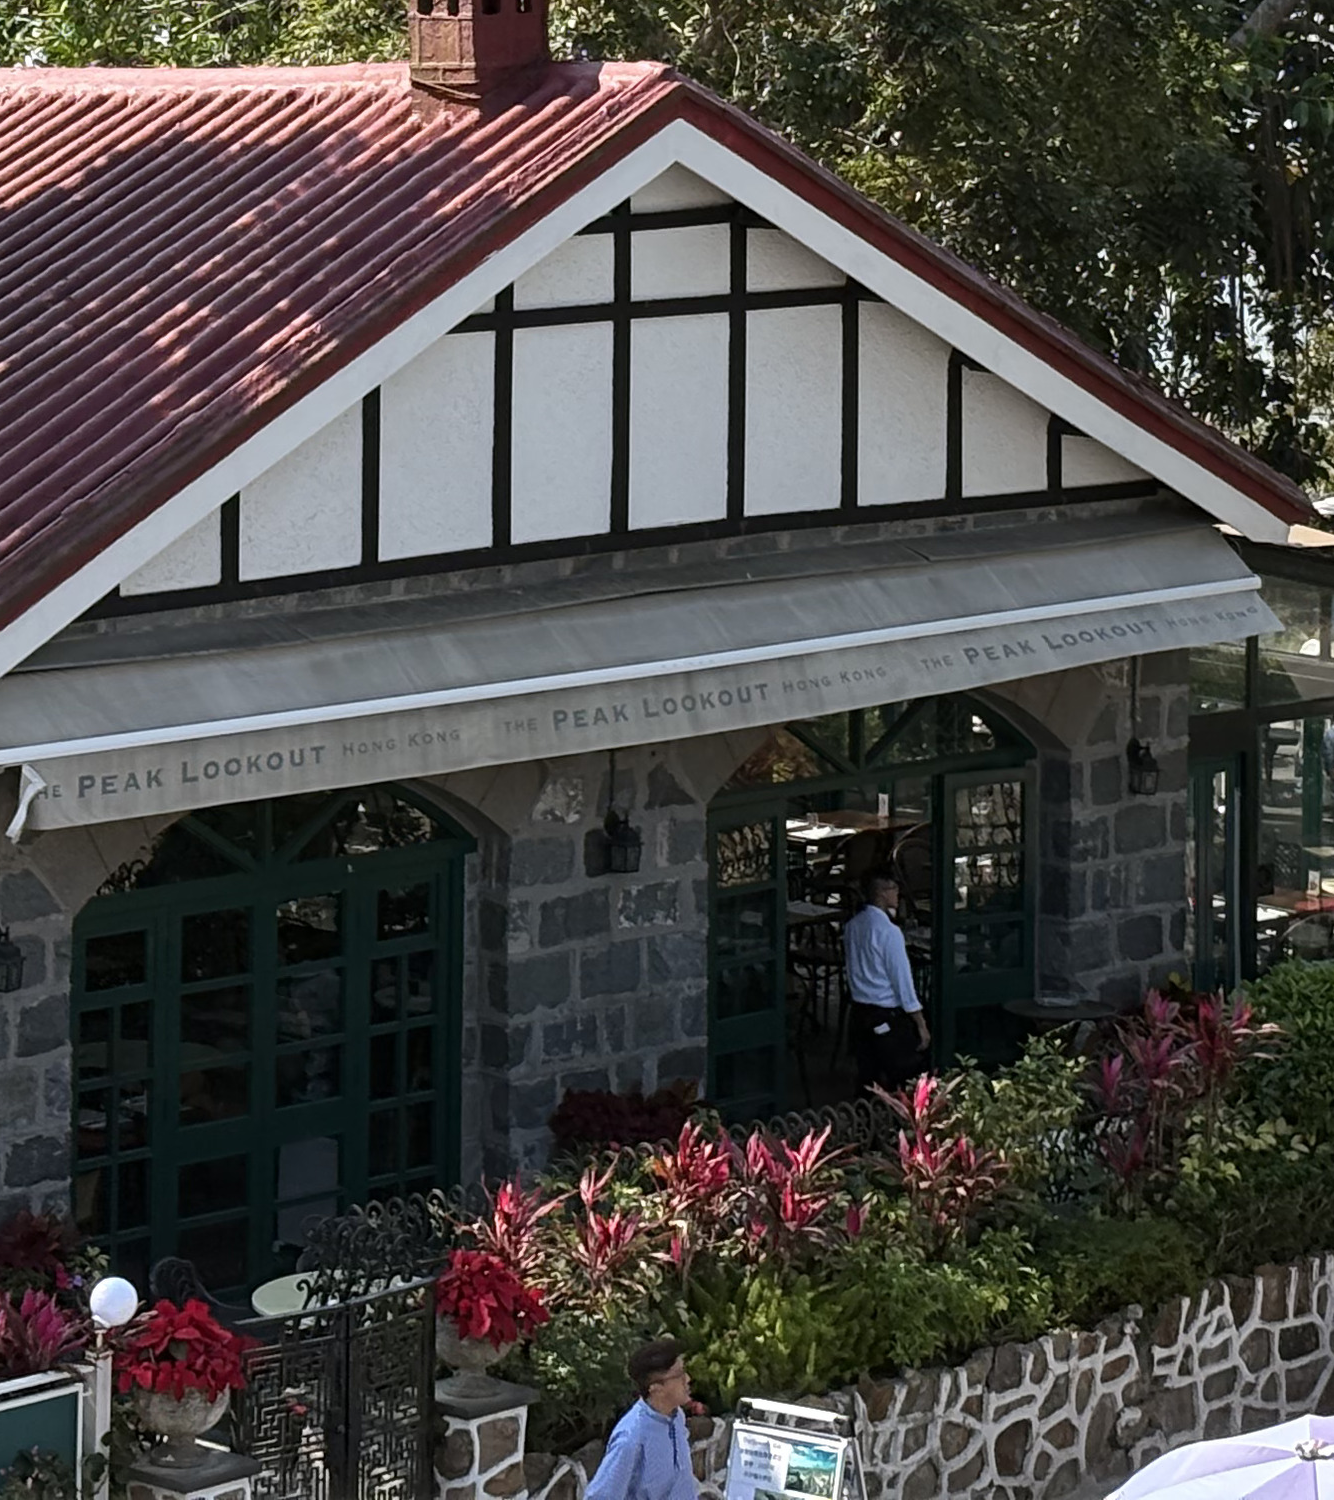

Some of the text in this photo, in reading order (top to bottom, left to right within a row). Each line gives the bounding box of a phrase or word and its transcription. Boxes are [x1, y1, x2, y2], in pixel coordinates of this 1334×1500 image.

[920, 654, 955, 672] THE
[963, 638, 1036, 666] PEAK
[1044, 618, 1159, 653] LOOKOUT
[503, 665, 887, 735] THE PEAK LOOKOUT HONG KONG
[37, 728, 462, 800] HE PEAK LOOKOUT HONG KONG
